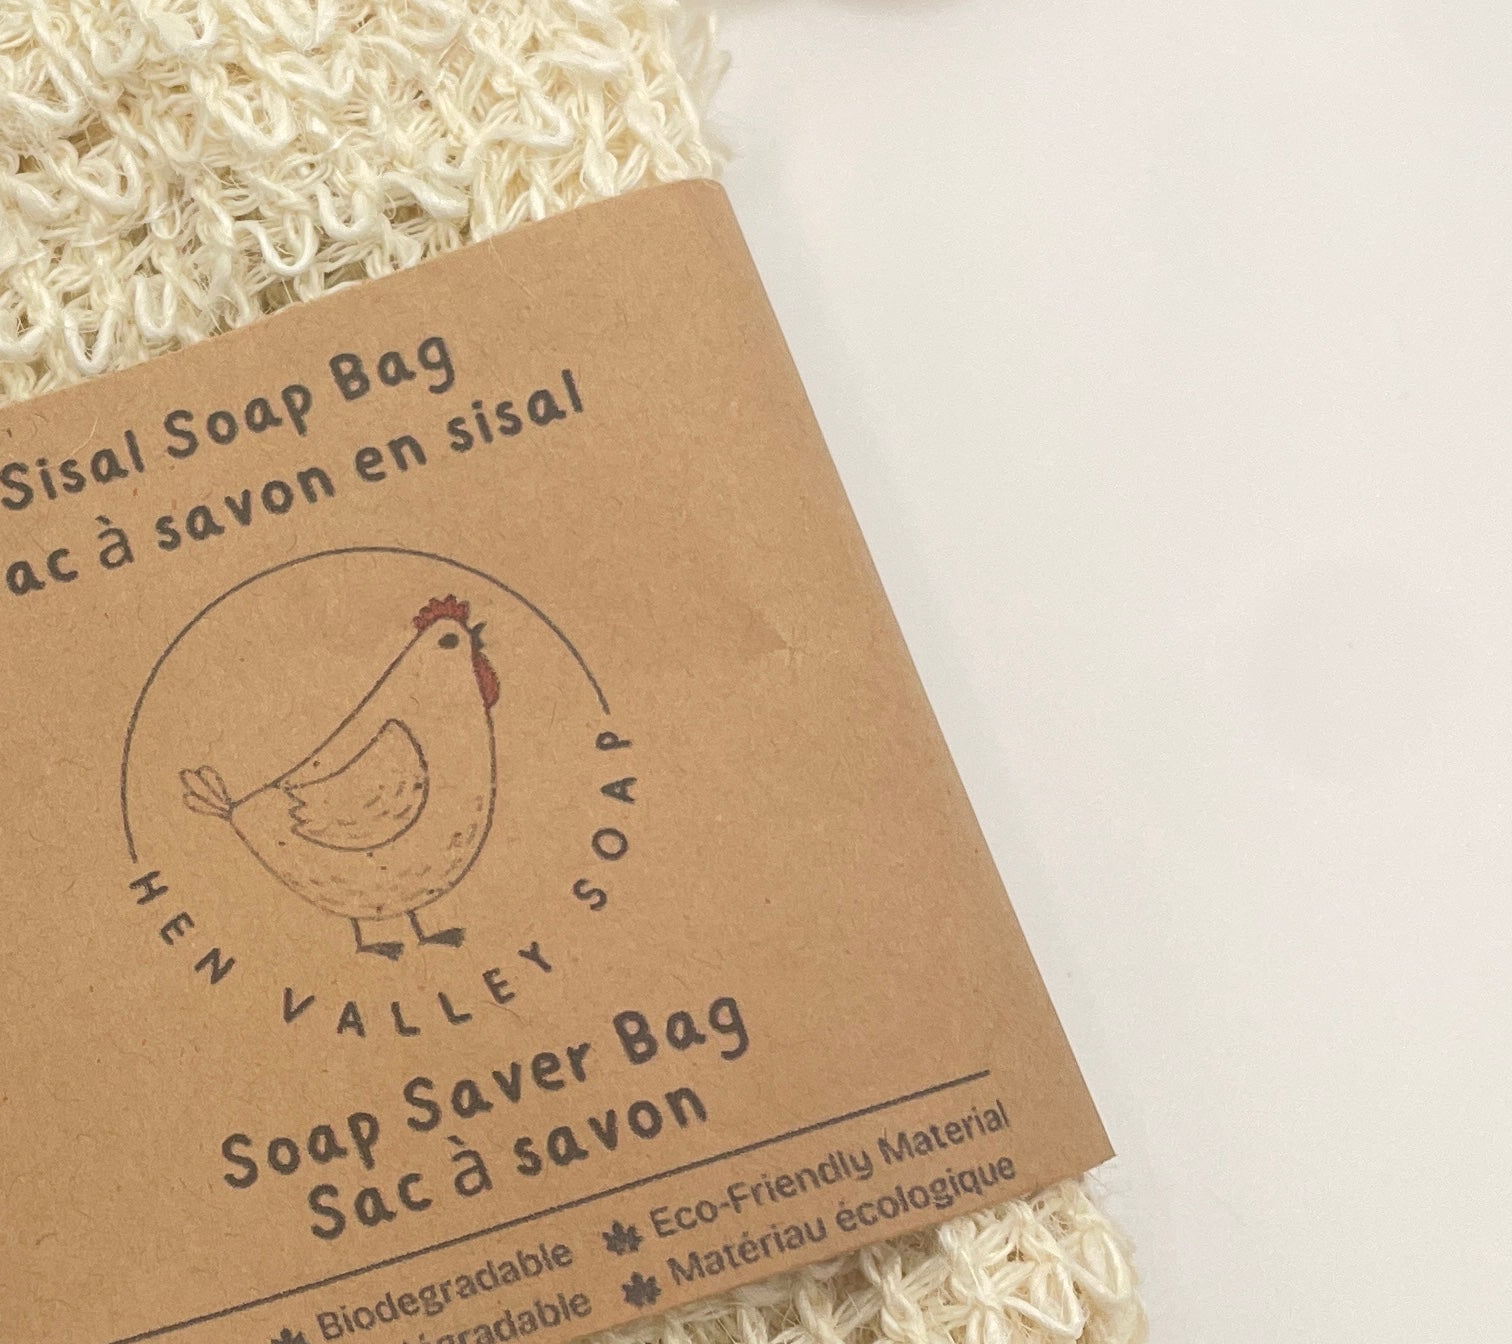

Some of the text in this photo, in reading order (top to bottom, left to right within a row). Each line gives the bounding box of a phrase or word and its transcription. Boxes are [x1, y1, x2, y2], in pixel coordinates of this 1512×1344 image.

[0, 336, 456, 511] Sisal Soap Bag
[94, 515, 135, 570] à
[156, 466, 336, 552] savon
[355, 435, 427, 483] en
[447, 369, 584, 454] sisal
[129, 730, 638, 1038] HEN VALLEY SOAP
[221, 996, 750, 1189] Soap Saver Bag
[307, 1087, 707, 1241] Sac à savon
[316, 1239, 574, 1341] Biodegradable
[649, 1149, 874, 1238] Eco-Friendly
[877, 1099, 1011, 1165] Material
[666, 1217, 829, 1287] Matériau
[835, 1157, 1017, 1232] écologique
